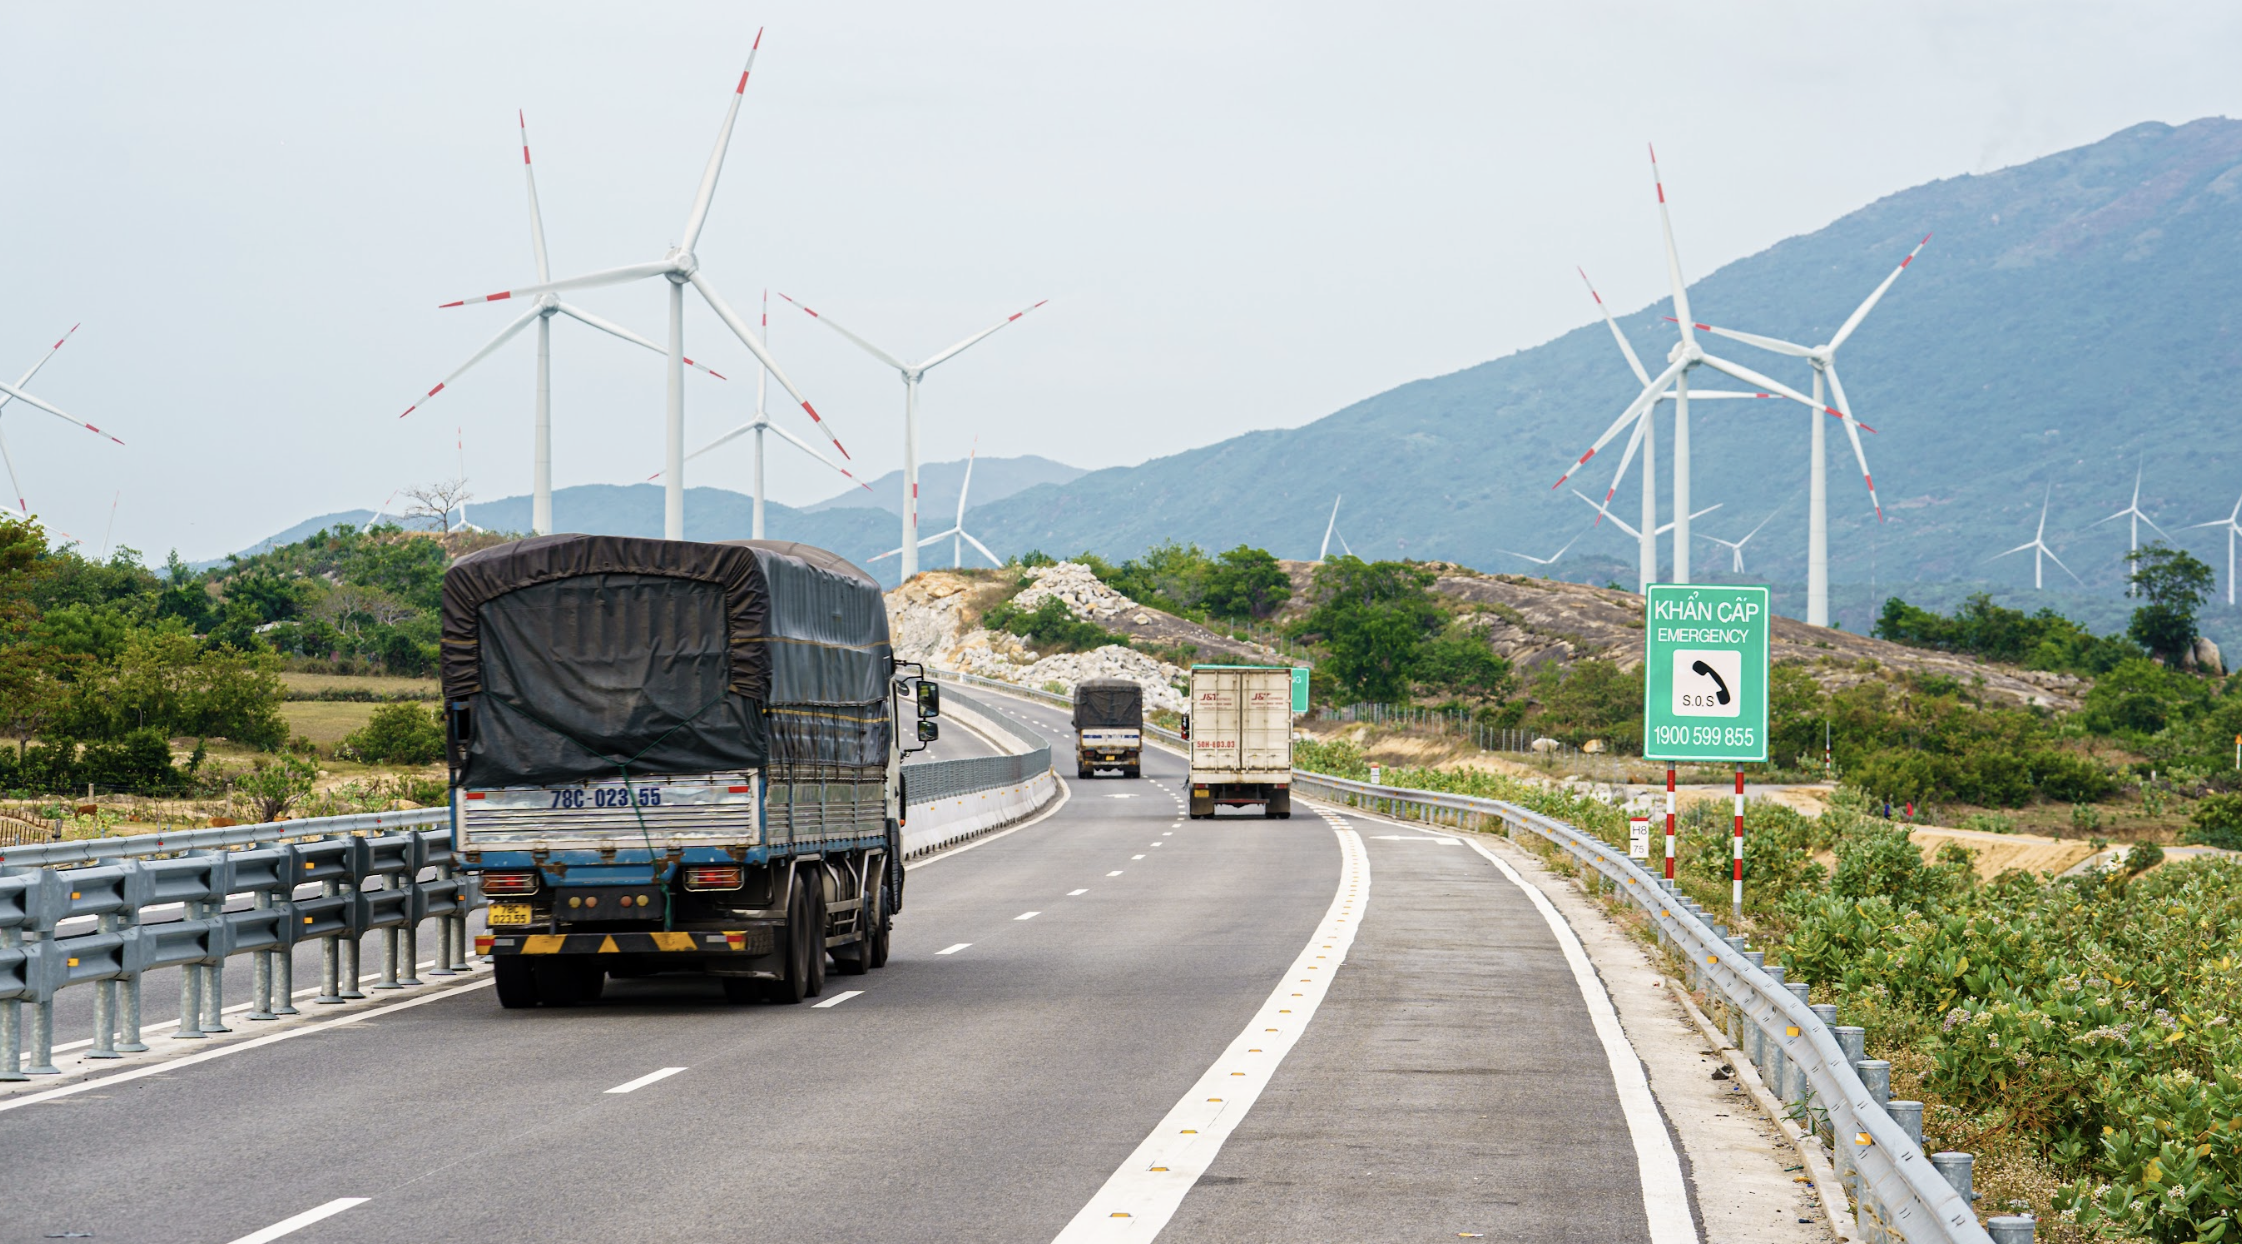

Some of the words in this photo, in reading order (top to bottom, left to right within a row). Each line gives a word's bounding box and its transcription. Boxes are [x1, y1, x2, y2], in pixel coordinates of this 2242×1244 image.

[1655, 591, 1712, 621] KHẨN
[1717, 597, 1759, 623] CẤP
[1658, 628, 1749, 643] EMERGENCY
[1654, 725, 1689, 745] 1900
[1692, 726, 1721, 746] 599
[1724, 727, 1754, 747] 855
[1632, 826, 1647, 835] H8
[1633, 845, 1645, 854] 75
